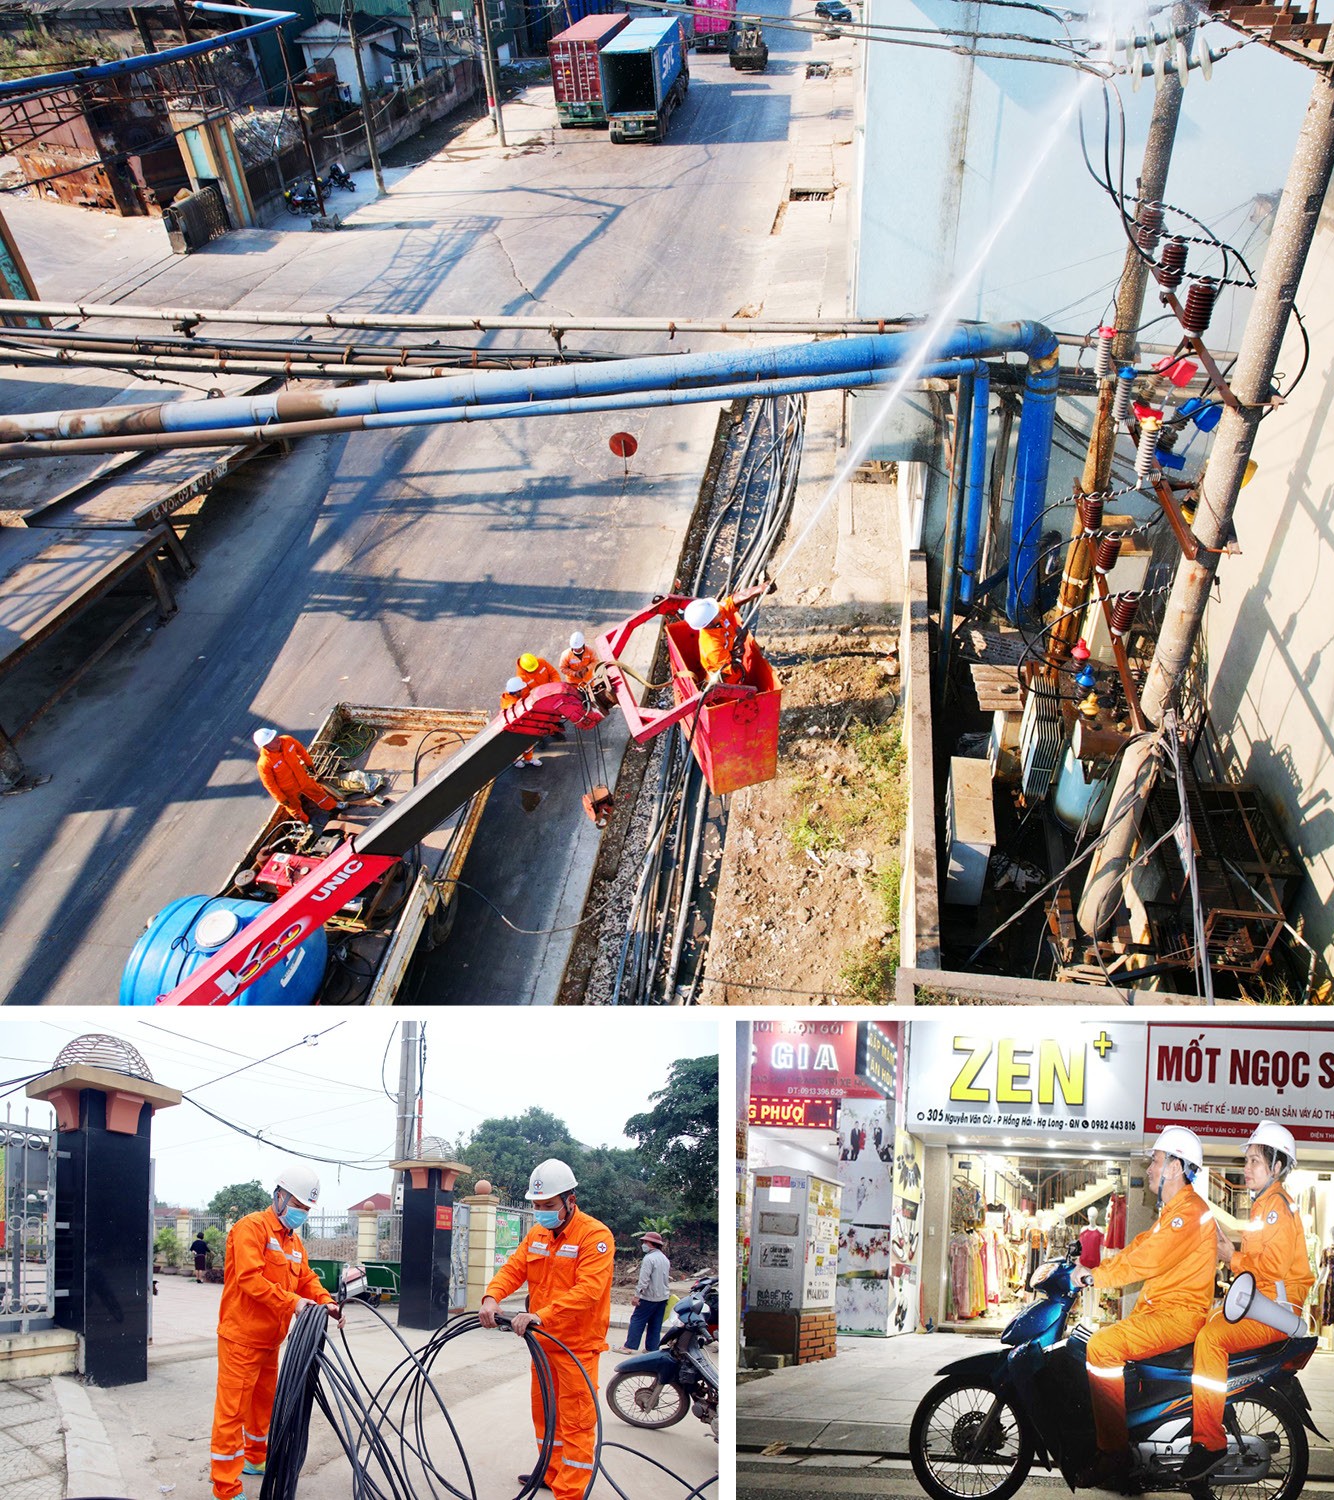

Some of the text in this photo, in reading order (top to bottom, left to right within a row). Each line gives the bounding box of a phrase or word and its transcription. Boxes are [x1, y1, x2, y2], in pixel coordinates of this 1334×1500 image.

[309, 859, 364, 902] UNIC
[770, 1041, 840, 1072] GIA
[1156, 1033, 1221, 1084] MỐT
[1229, 1048, 1310, 1095] NGỌC
[944, 1112, 968, 1125] Nguyễn
[1002, 1114, 1020, 1127] Hồng
[1036, 1117, 1047, 1129] Hạ
[1047, 1118, 1064, 1130] Long
[1091, 1120, 1108, 1130] 0982
[1110, 1120, 1124, 1131] 443
[1124, 1120, 1136, 1131] 816
[1161, 1101, 1172, 1111] TƯ
[1173, 1099, 1187, 1112] VẤN
[1193, 1101, 1214, 1113] THIẾT
[1215, 1101, 1227, 1114] KẾ
[1231, 1105, 1246, 1115] MAY
[1247, 1106, 1259, 1116] ĐO
[1265, 1105, 1280, 1117] BÁN
[1299, 1107, 1312, 1118] VÁY
[1312, 1107, 1323, 1119] ÁO
